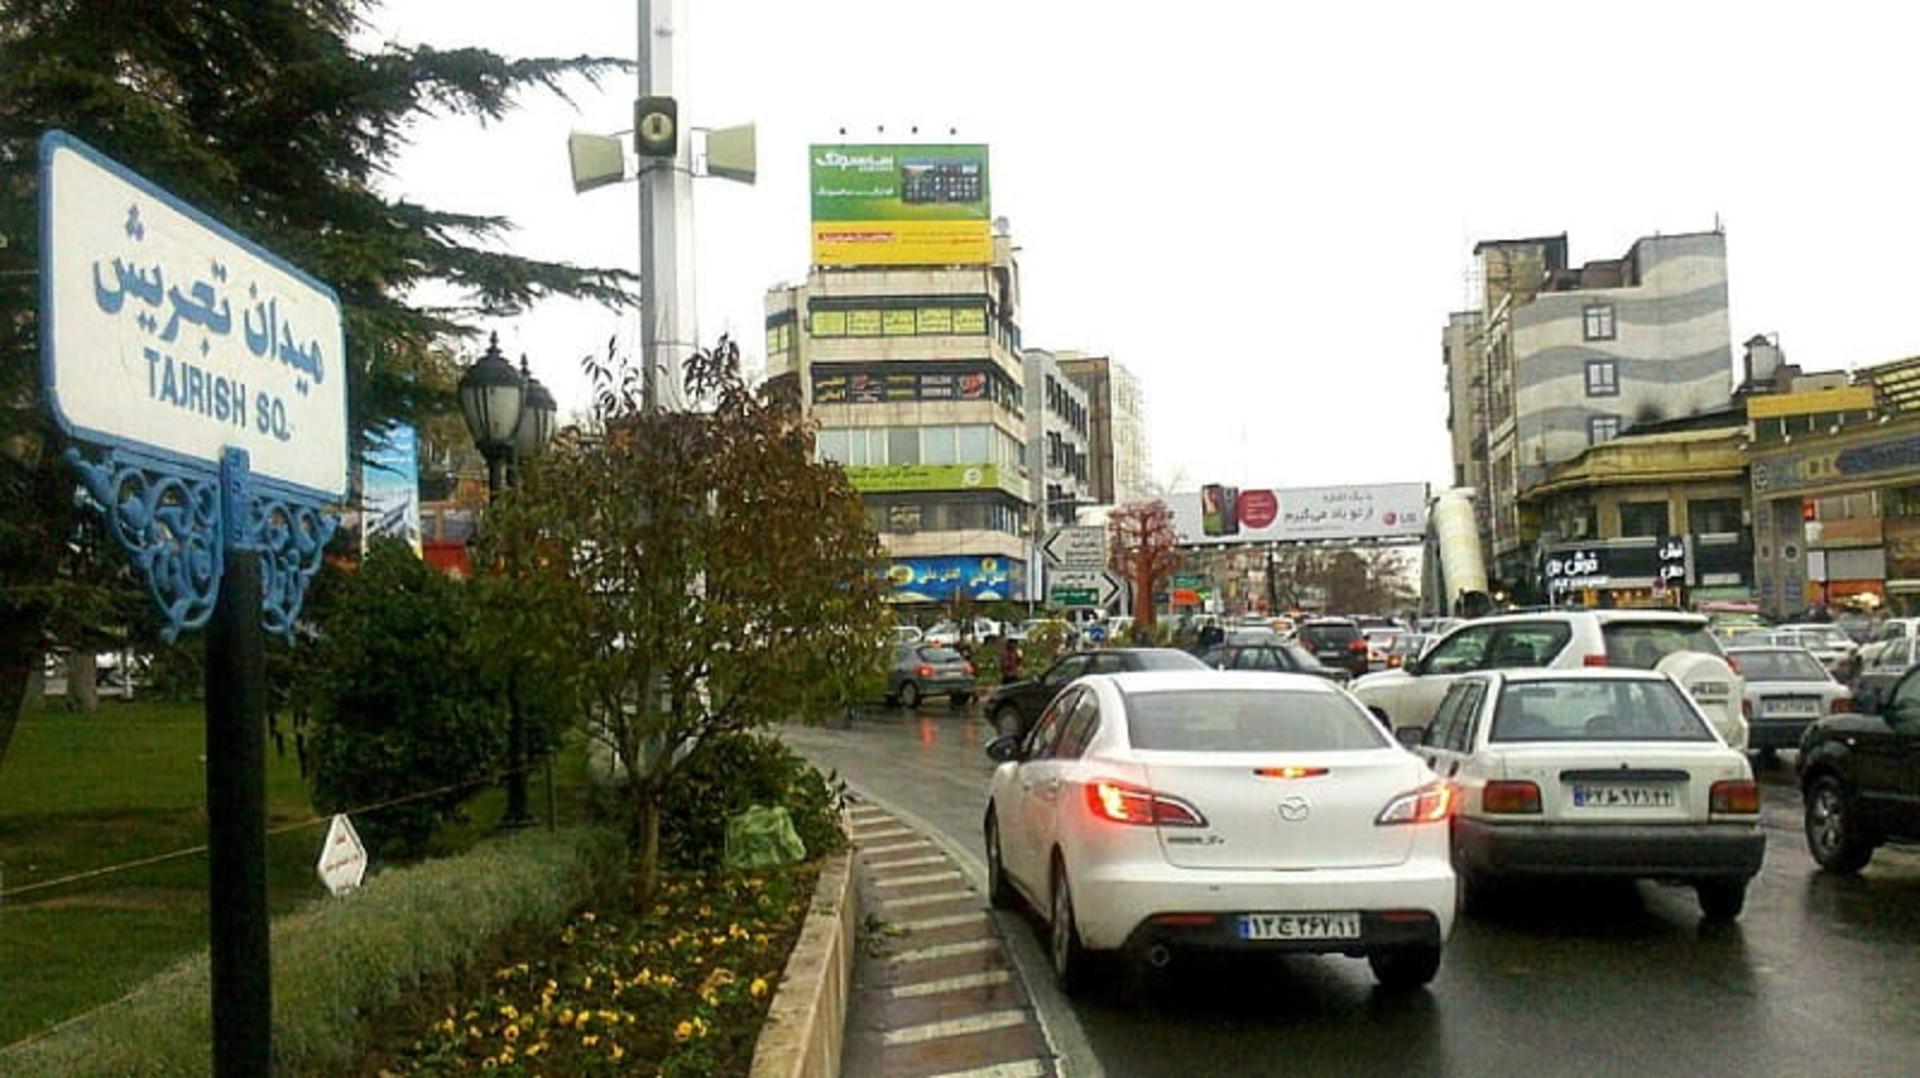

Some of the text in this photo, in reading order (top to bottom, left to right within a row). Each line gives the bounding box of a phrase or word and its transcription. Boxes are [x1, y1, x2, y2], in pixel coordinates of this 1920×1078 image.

[93, 204, 324, 396] میدان تجریش
[144, 347, 246, 428] TAJRISH
